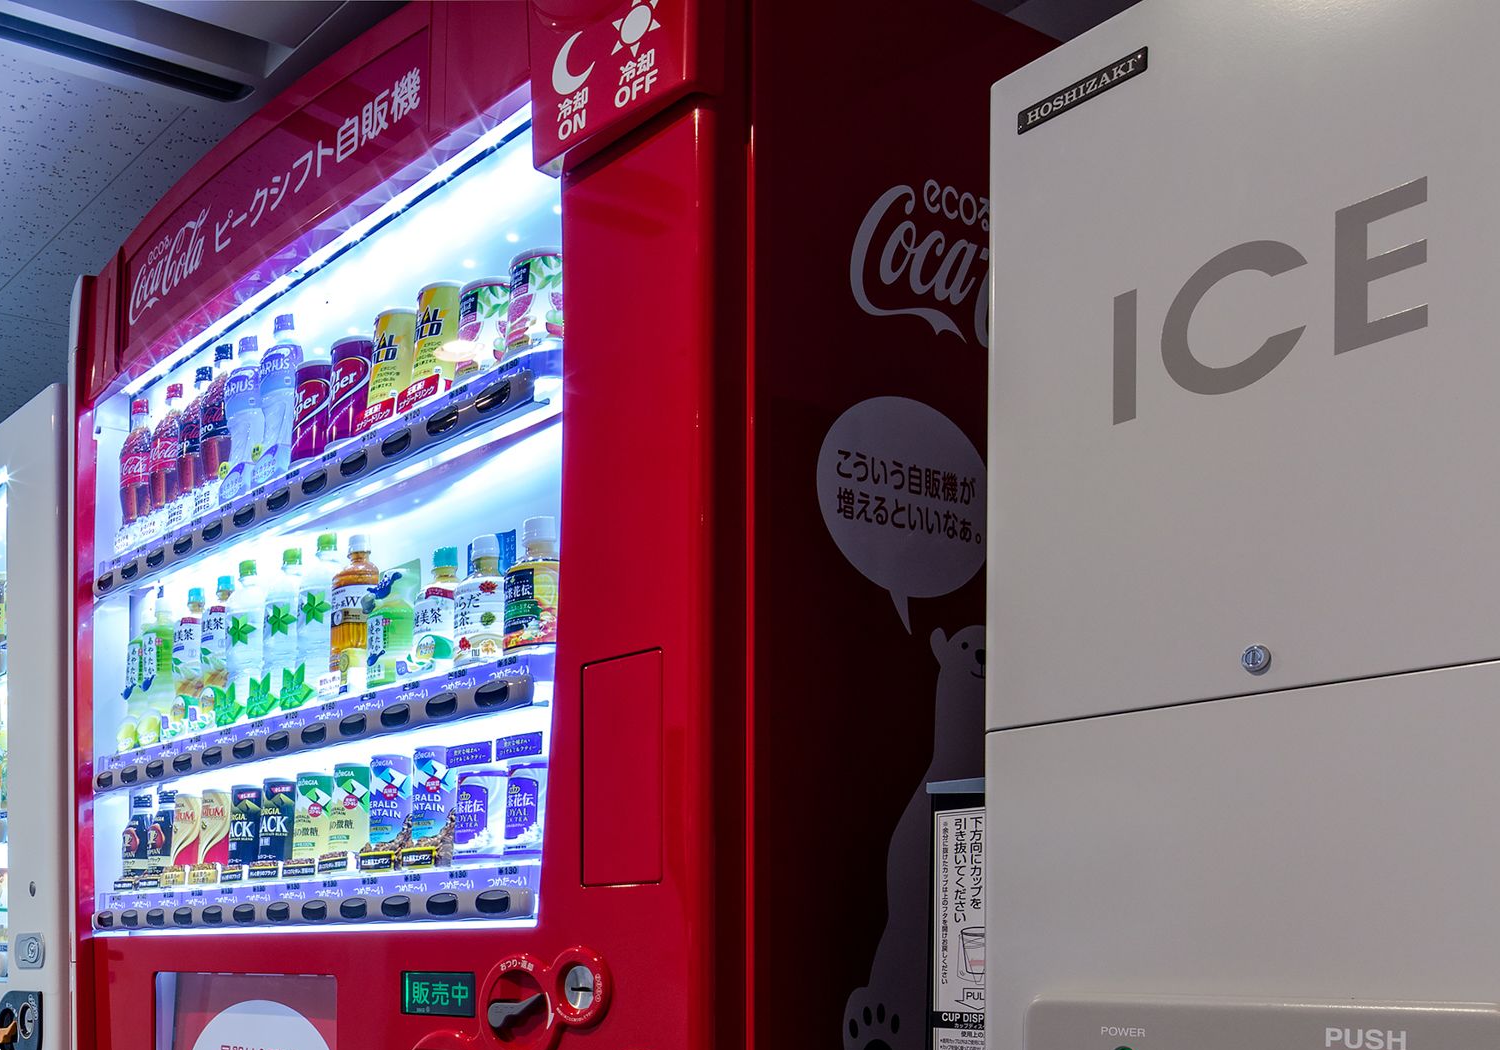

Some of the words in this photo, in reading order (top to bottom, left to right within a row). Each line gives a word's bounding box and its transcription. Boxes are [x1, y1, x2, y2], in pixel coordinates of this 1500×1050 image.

[619, 48, 655, 86] 冷却
[556, 86, 588, 122] 冷却
[614, 68, 658, 108] OFF
[1026, 56, 1136, 126] HOSHIZAKI
[558, 109, 586, 141] ON
[215, 66, 421, 253] ピークシフト自販機
[128, 203, 212, 326] Coca-Cola
[1113, 176, 1428, 426] ICE
[836, 448, 977, 506] こういう自販機が
[953, 818, 967, 924] 引き抜いてください
[969, 816, 983, 910] 下方向にカップを
[411, 981, 470, 1007] 販売中
[941, 1012, 961, 1023] CUP
[1100, 1026, 1146, 1038] POWER
[1324, 1027, 1407, 1050] PUSH
